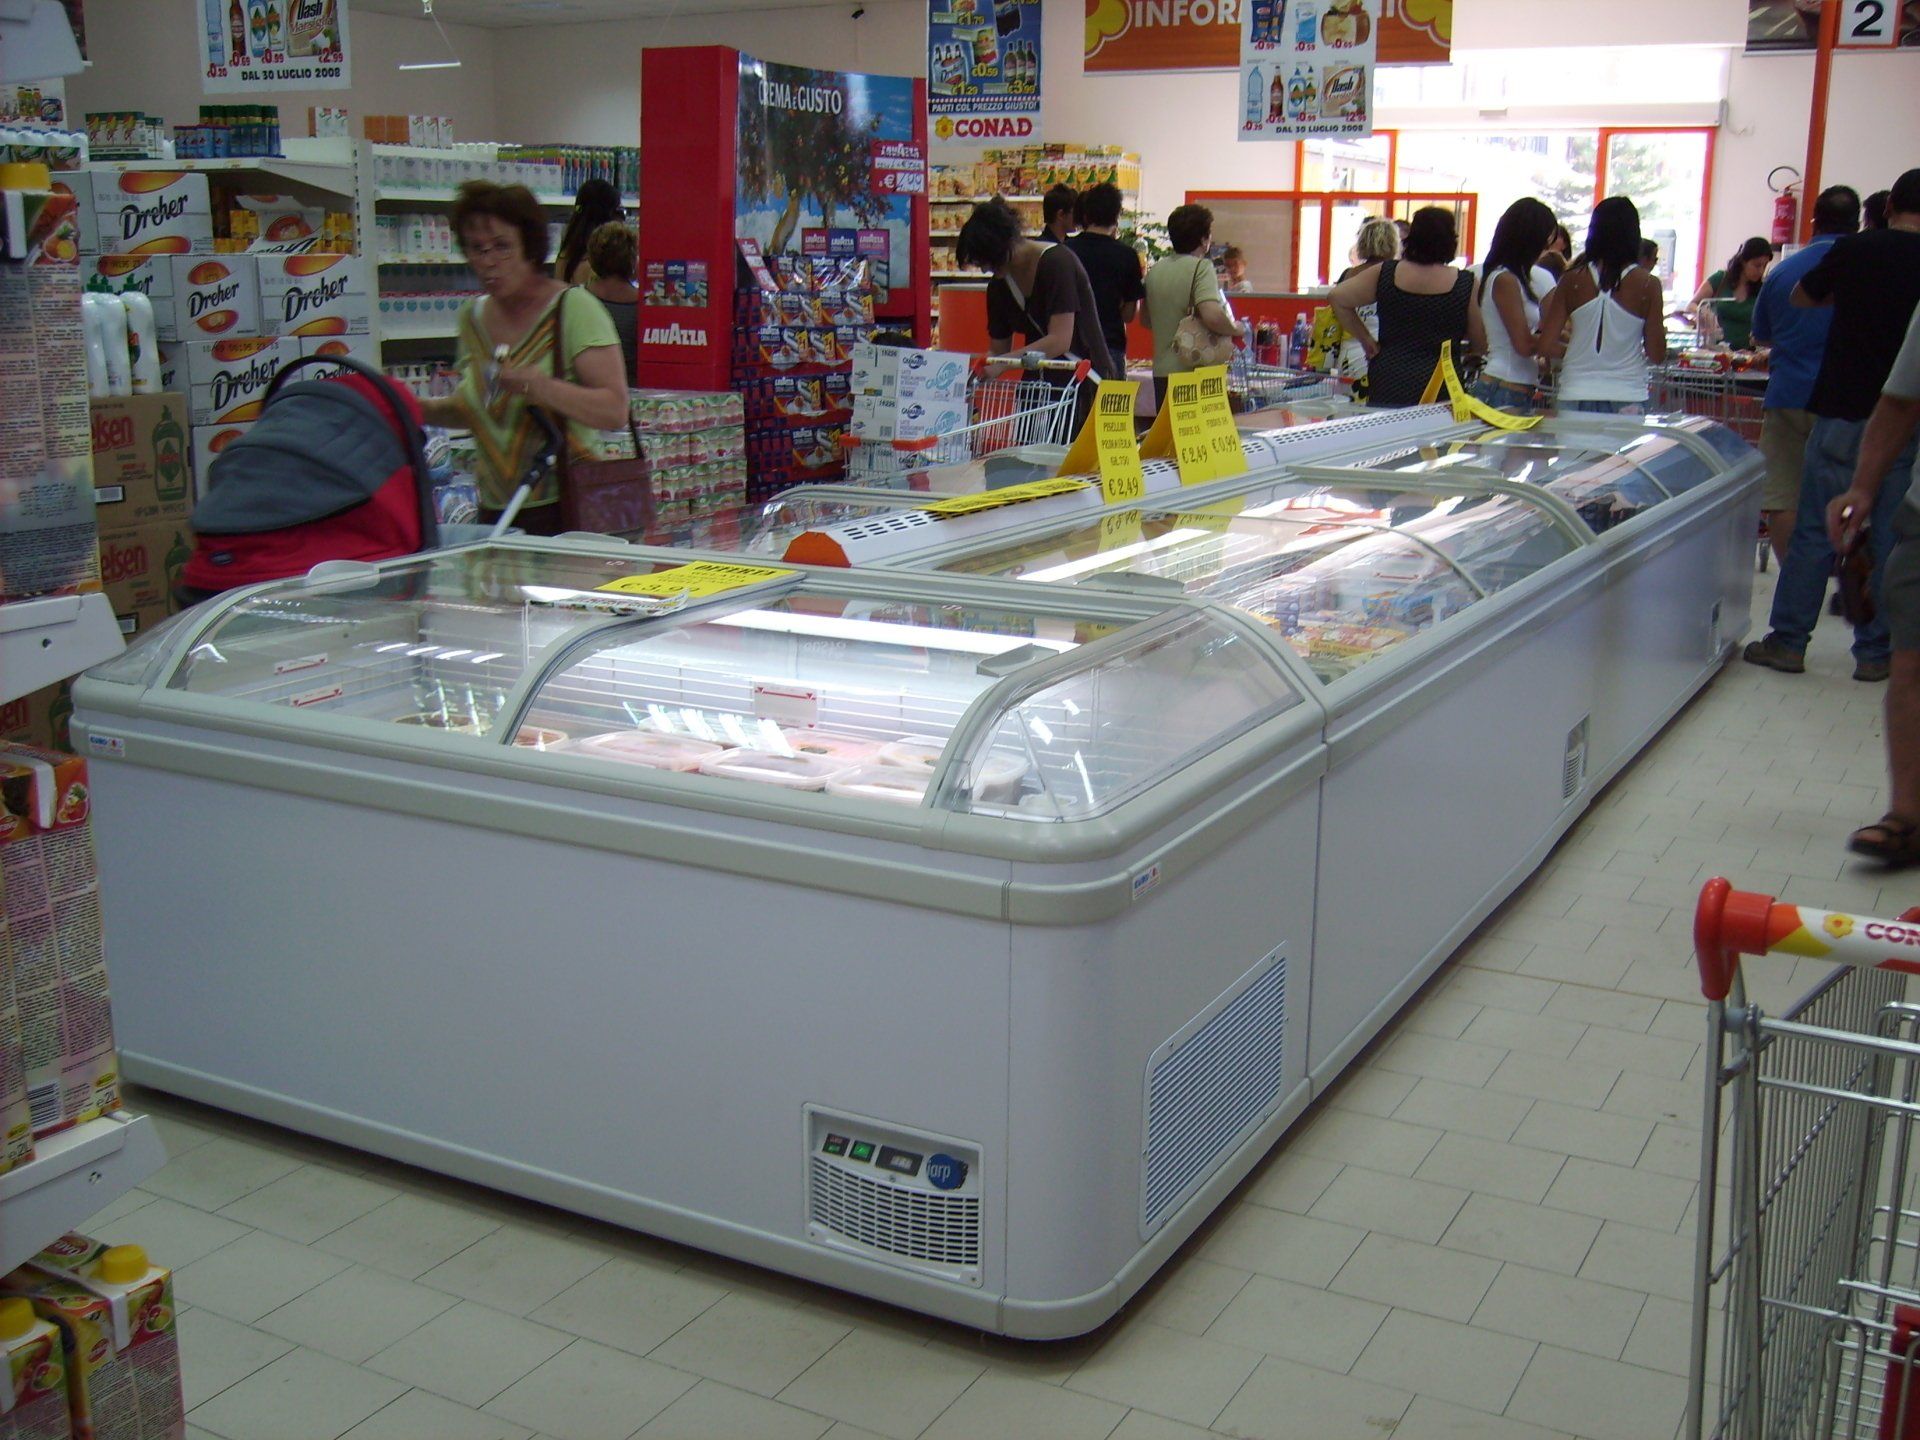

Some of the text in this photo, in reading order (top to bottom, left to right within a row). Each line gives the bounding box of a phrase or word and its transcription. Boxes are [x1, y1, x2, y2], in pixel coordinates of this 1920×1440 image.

[1852, 0, 1884, 37] 2
[241, 67, 341, 81] DAL 30 LUGLIO 2008
[758, 80, 791, 109] CREMA
[797, 86, 842, 115] GUSTO
[931, 101, 1037, 112] PARTI COL PREZZO GIUSTO!
[955, 117, 1033, 137] CONAD
[1275, 124, 1291, 134] DAL
[1308, 124, 1338, 132] LUGLIO
[119, 195, 188, 240] Dreher
[187, 281, 240, 318] Dreher
[281, 275, 348, 323] Dreher
[642, 323, 708, 346] LAVAZZA
[210, 356, 280, 411] Dreher
[1173, 384, 1197, 404] OFFERTA
[1101, 393, 1131, 413] OFFERTA
[927, 1160, 951, 1183] iarp
